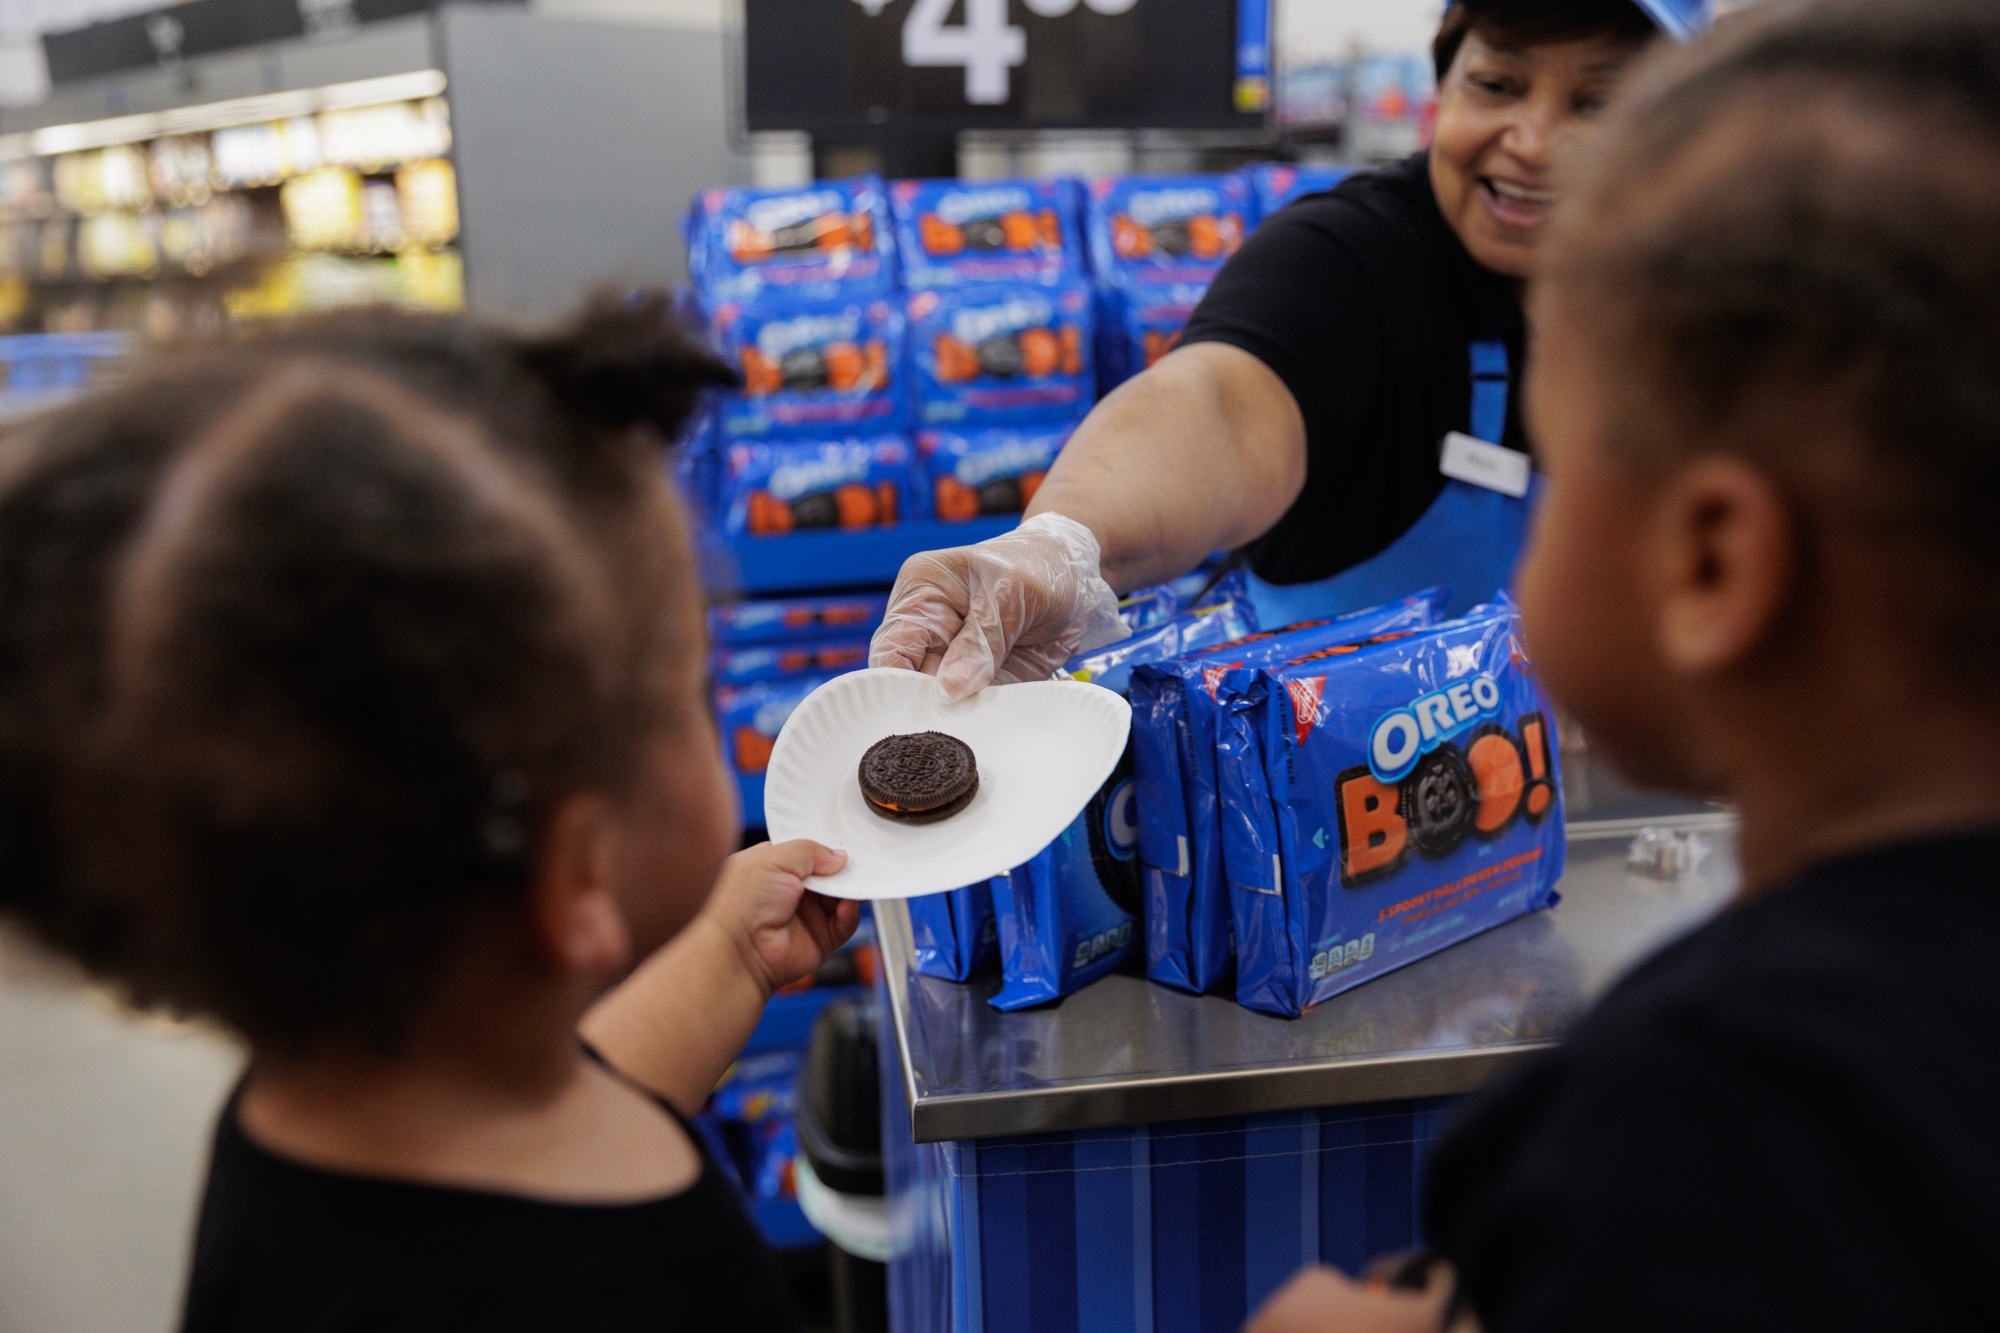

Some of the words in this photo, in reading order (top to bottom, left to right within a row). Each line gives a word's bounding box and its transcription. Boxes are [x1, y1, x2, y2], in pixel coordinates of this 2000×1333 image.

[1371, 675, 1500, 772] OREO
[896, 756, 939, 772] OREO
[1286, 758, 1294, 774] FEB
[1339, 718, 1552, 880] BOO!
[1388, 892, 1433, 916] SPOOKY
[1433, 864, 1500, 897] HALLOWEEN
